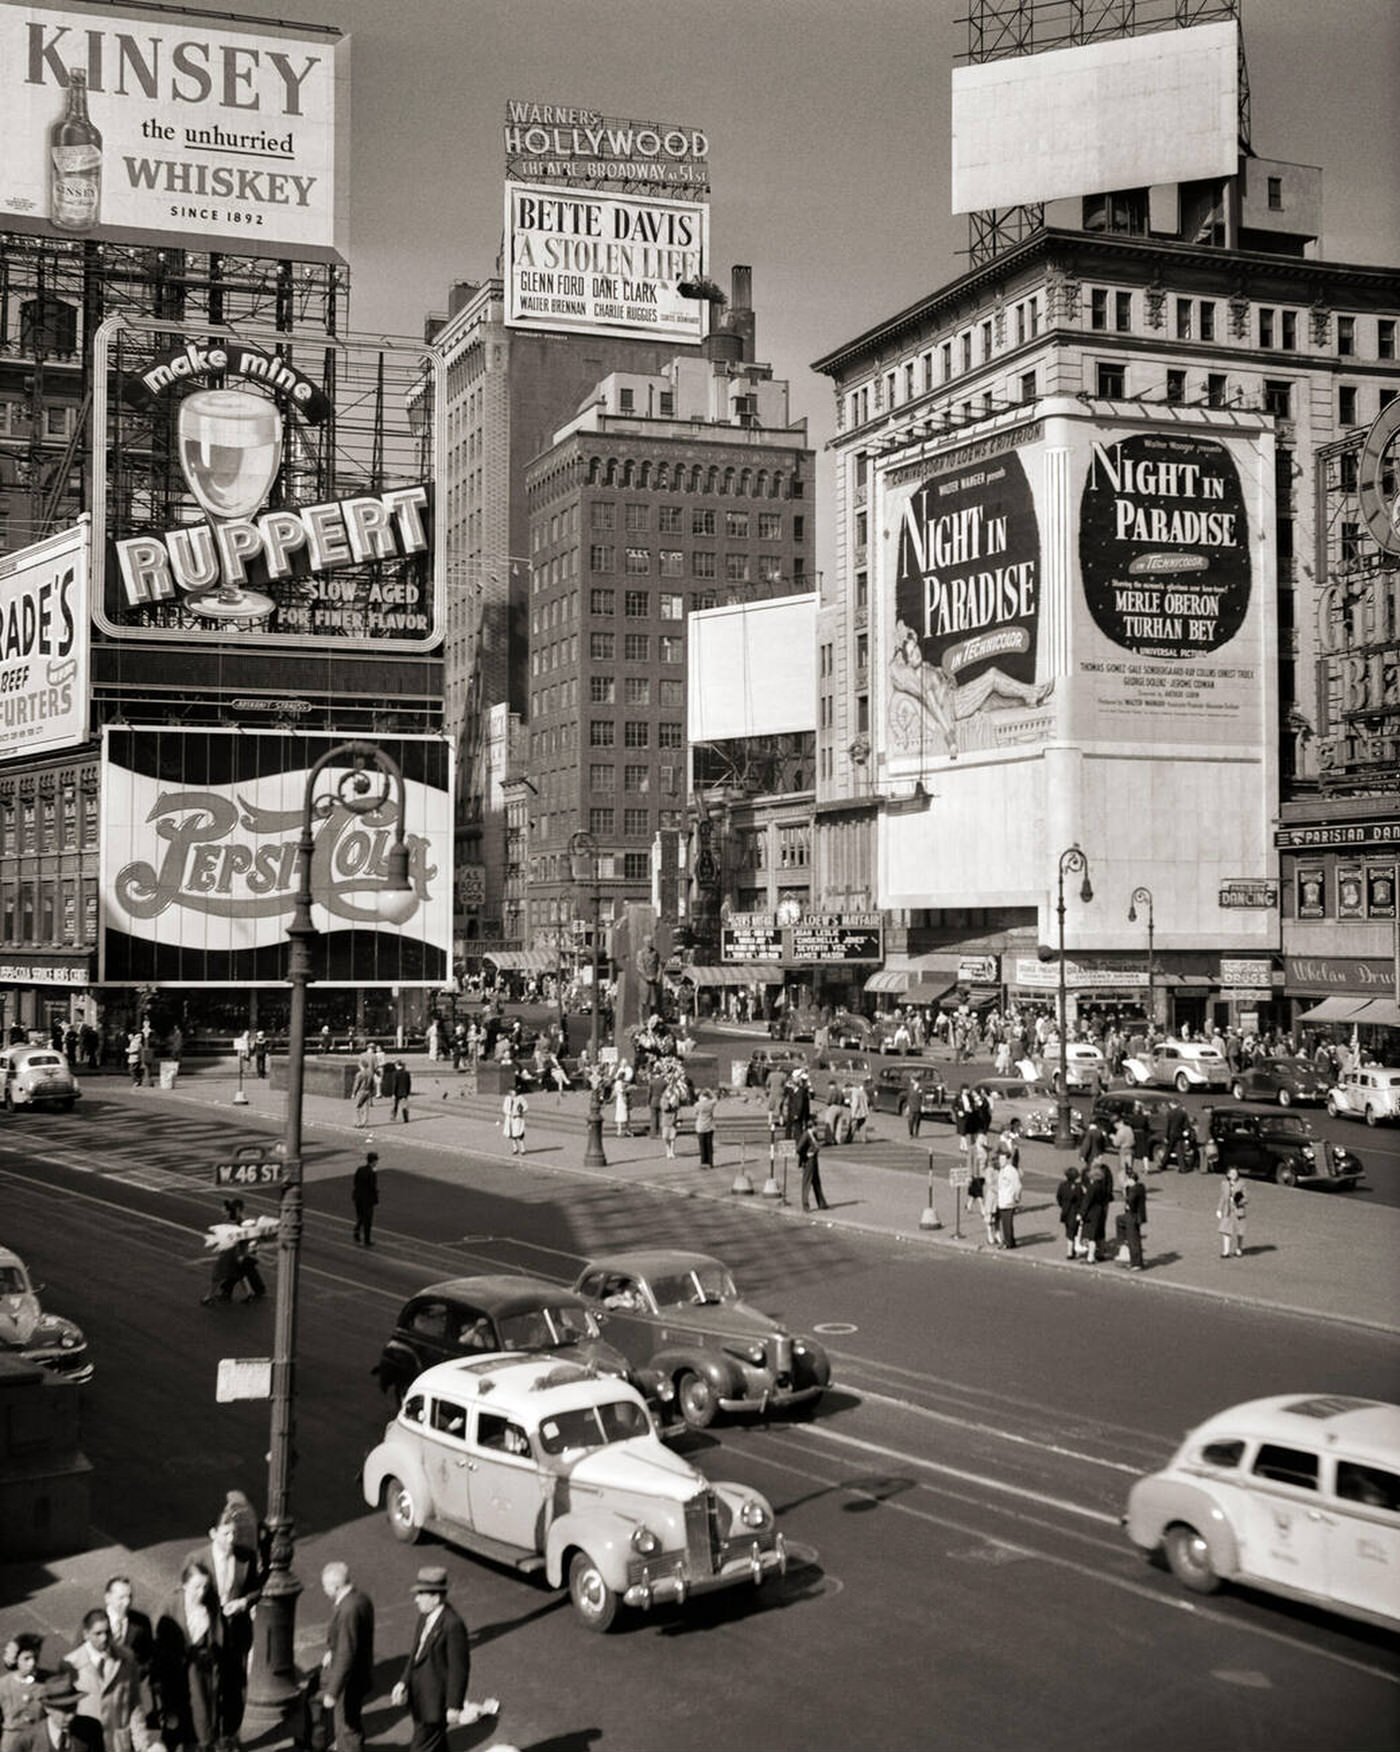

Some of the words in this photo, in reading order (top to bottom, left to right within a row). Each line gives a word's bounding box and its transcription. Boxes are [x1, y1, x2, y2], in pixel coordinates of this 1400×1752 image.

[25, 22, 321, 116] KINSEY
[142, 119, 175, 141] the
[185, 124, 294, 154] unhurried
[505, 127, 709, 157] HOLLYWOOD
[123, 156, 317, 206] WHISKEY
[522, 160, 579, 176] THEATRE
[588, 161, 666, 181] BROADWAY
[171, 206, 219, 221] SINCE
[227, 211, 264, 225] 1892
[519, 197, 602, 237] BETTE
[614, 207, 692, 247] DAVIS
[544, 238, 635, 278] STOLEN
[520, 270, 554, 296] GLENN
[557, 274, 585, 297] FORD
[592, 276, 619, 301] DANE
[623, 282, 658, 304] CLARK
[519, 295, 550, 313] WALTER
[551, 298, 587, 316] BRENNAN
[594, 301, 624, 319] CHARLIE
[626, 306, 658, 323] RUGGLES
[143, 345, 228, 395] make
[241, 352, 313, 401] mine
[990, 424, 1042, 453] CRITERION
[1089, 440, 1200, 497] NIGHT
[1202, 476, 1224, 499] IN
[902, 490, 984, 578] NIGHT
[986, 516, 1008, 556] IN
[1114, 499, 1237, 547] PARADISE
[115, 487, 428, 606] RUPPERT
[1146, 555, 1204, 570] TECHNICOLOR
[0, 567, 75, 661] ADE'S
[923, 561, 1035, 639] PARADISE
[1115, 591, 1160, 614] MERLE
[1164, 593, 1220, 617] OBERON
[278, 607, 310, 625] FOR
[315, 609, 365, 628] FINER
[369, 611, 427, 631] FLAVOR
[1123, 615, 1183, 639] TURHAN
[1189, 619, 1217, 642] BEY
[950, 651, 962, 670] IN
[963, 632, 1023, 663] TECHNICOLOR
[1139, 647, 1178, 658] UNIVERSAL
[1, 665, 30, 694] BEEF
[1080, 662, 1104, 673] THOMAS
[0, 683, 72, 728] URTERS
[1305, 828, 1365, 844] PARISIAN
[1222, 892, 1274, 906] DANCING
[803, 914, 840, 926] LOEW'S
[842, 914, 880, 927] MAYFAIR
[1292, 961, 1347, 983] Whelan
[235, 1164, 257, 1183] 46
[261, 1164, 281, 1182] ST
